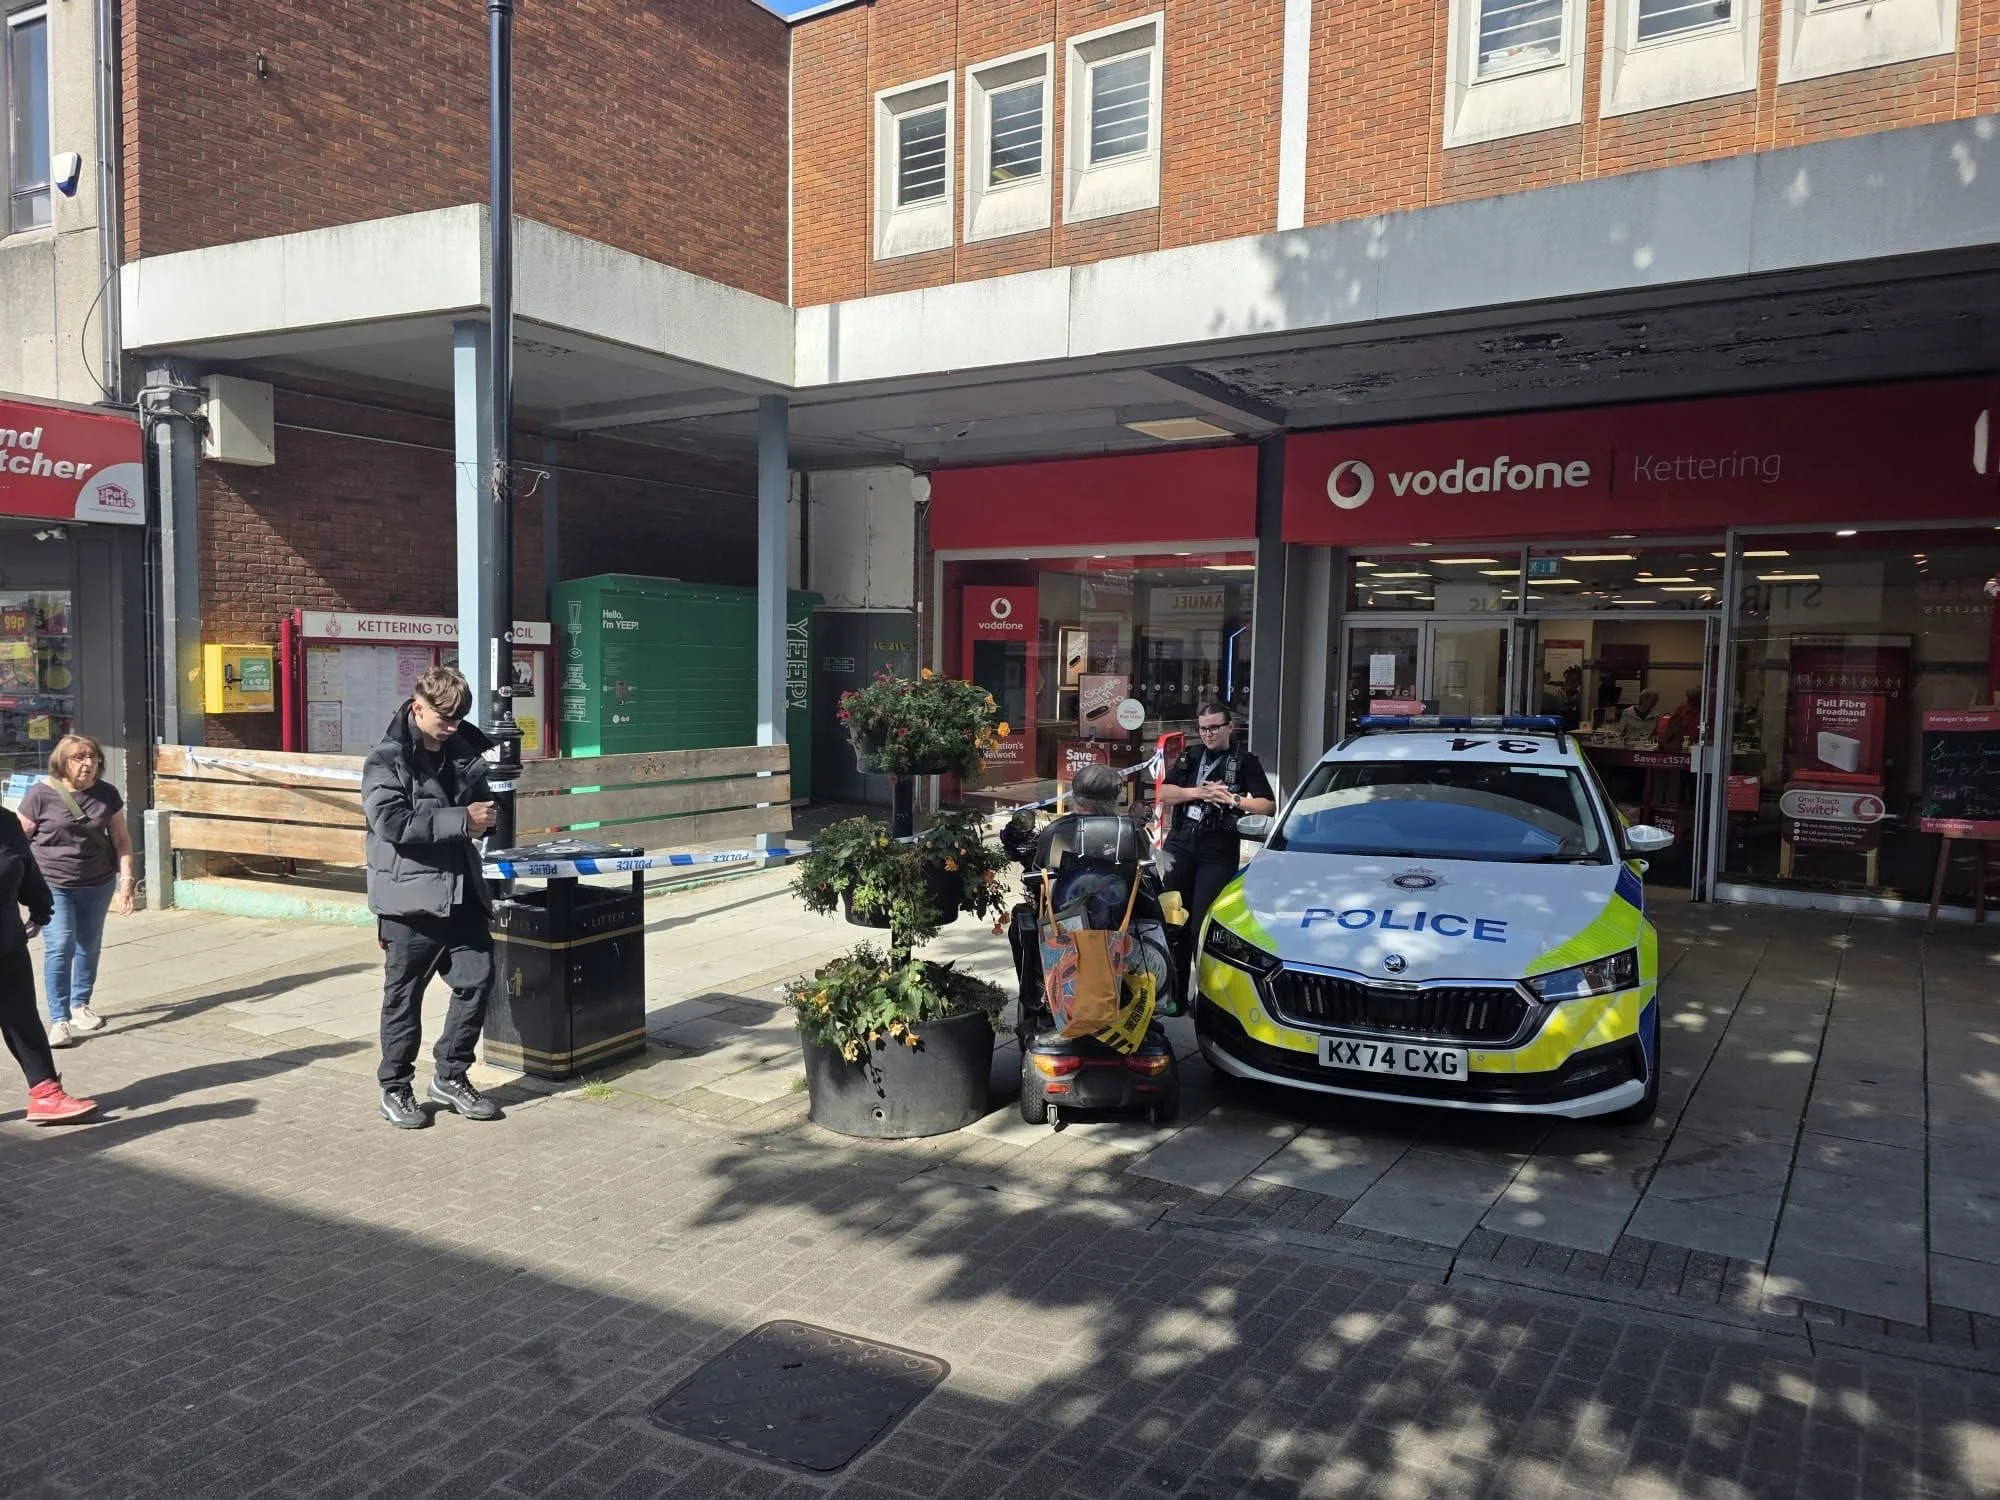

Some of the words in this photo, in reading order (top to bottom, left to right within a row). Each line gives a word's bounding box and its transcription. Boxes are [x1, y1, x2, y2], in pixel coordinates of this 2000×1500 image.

[1389, 455, 1590, 498] vodafone
[1633, 447, 1781, 486] Kettering
[603, 609, 623, 620] Hello,
[4, 614, 25, 633] 99p
[358, 620, 432, 634] KETTERING
[603, 620, 614, 629] I'm
[616, 620, 639, 630] YEEP!
[978, 620, 1024, 630] vodafone
[1817, 699, 1836, 708] Full
[1839, 700, 1867, 709] Fibre
[1816, 708, 1866, 717] Broadband
[1066, 749, 1092, 761] Save
[1633, 753, 1657, 763] Save
[1663, 755, 1690, 765] £1574
[1797, 803, 1839, 816] Switch
[712, 852, 750, 864] POLICE
[529, 864, 559, 876] POLICE
[616, 858, 653, 872] POLICE
[592, 911, 626, 929] LITTER
[1301, 908, 1508, 944] POLICE
[1328, 1040, 1396, 1070] KX74
[1404, 1048, 1458, 1076] CXG
